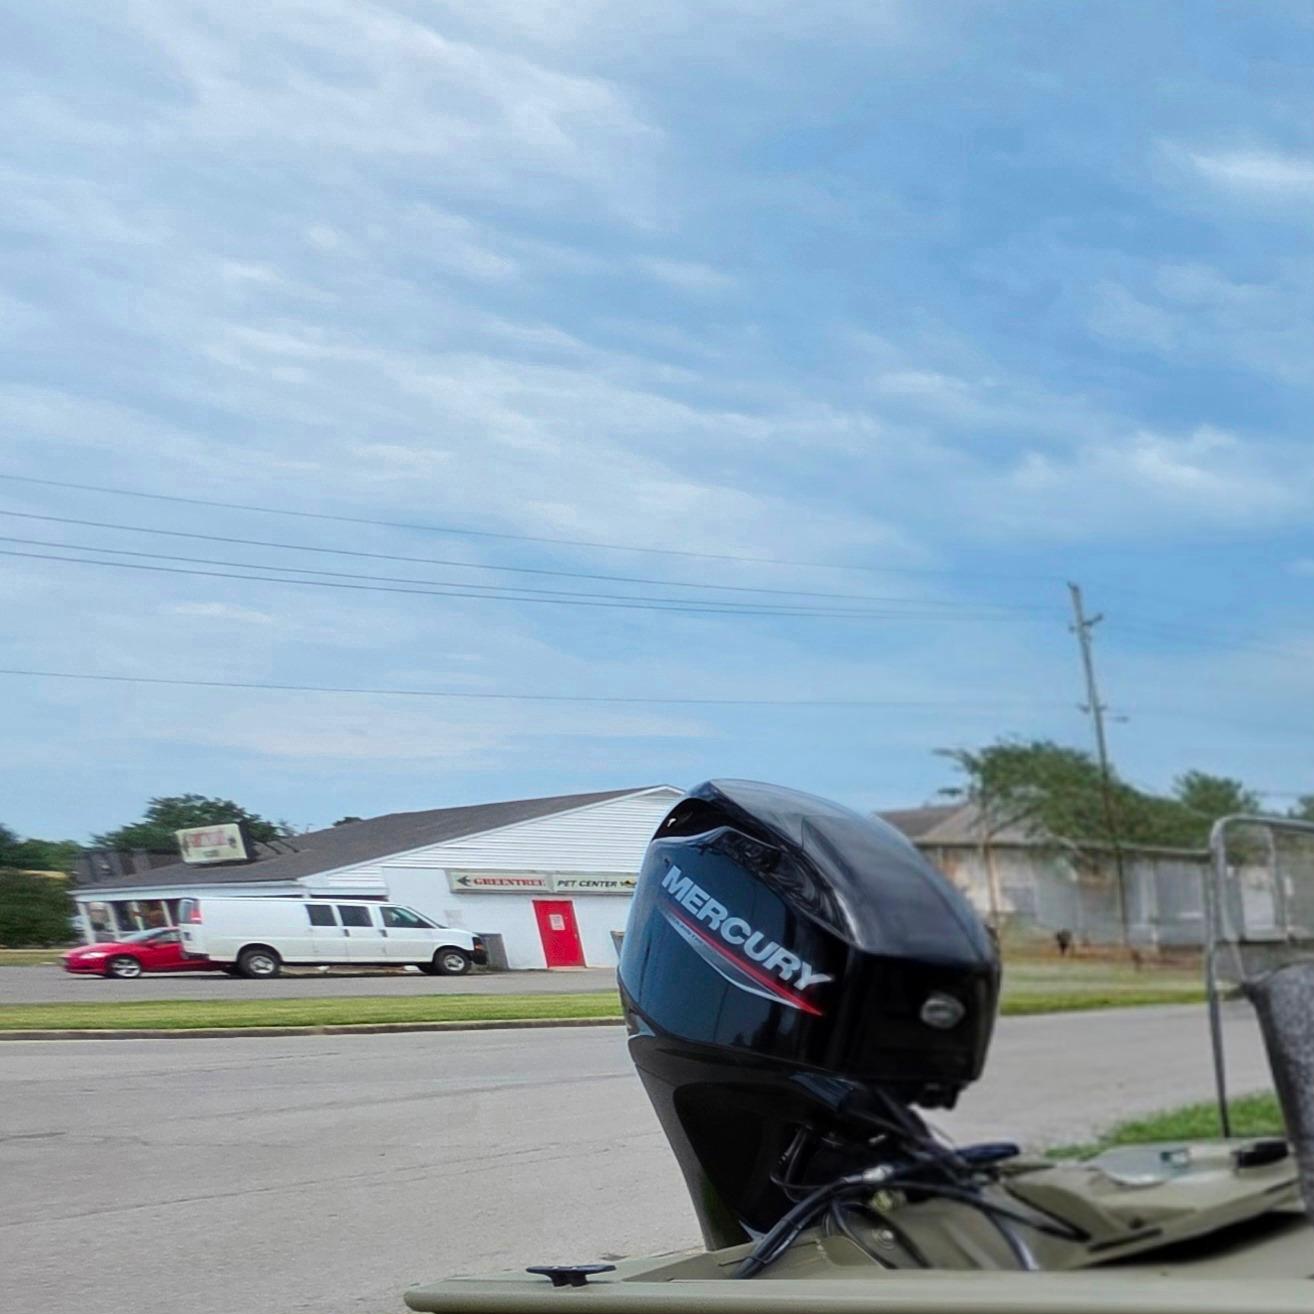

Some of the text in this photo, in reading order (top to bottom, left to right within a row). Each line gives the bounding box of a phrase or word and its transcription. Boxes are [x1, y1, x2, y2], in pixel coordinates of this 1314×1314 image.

[473, 878, 617, 888] GREENTREE PET CENTER
[662, 865, 832, 990] MERCURY
